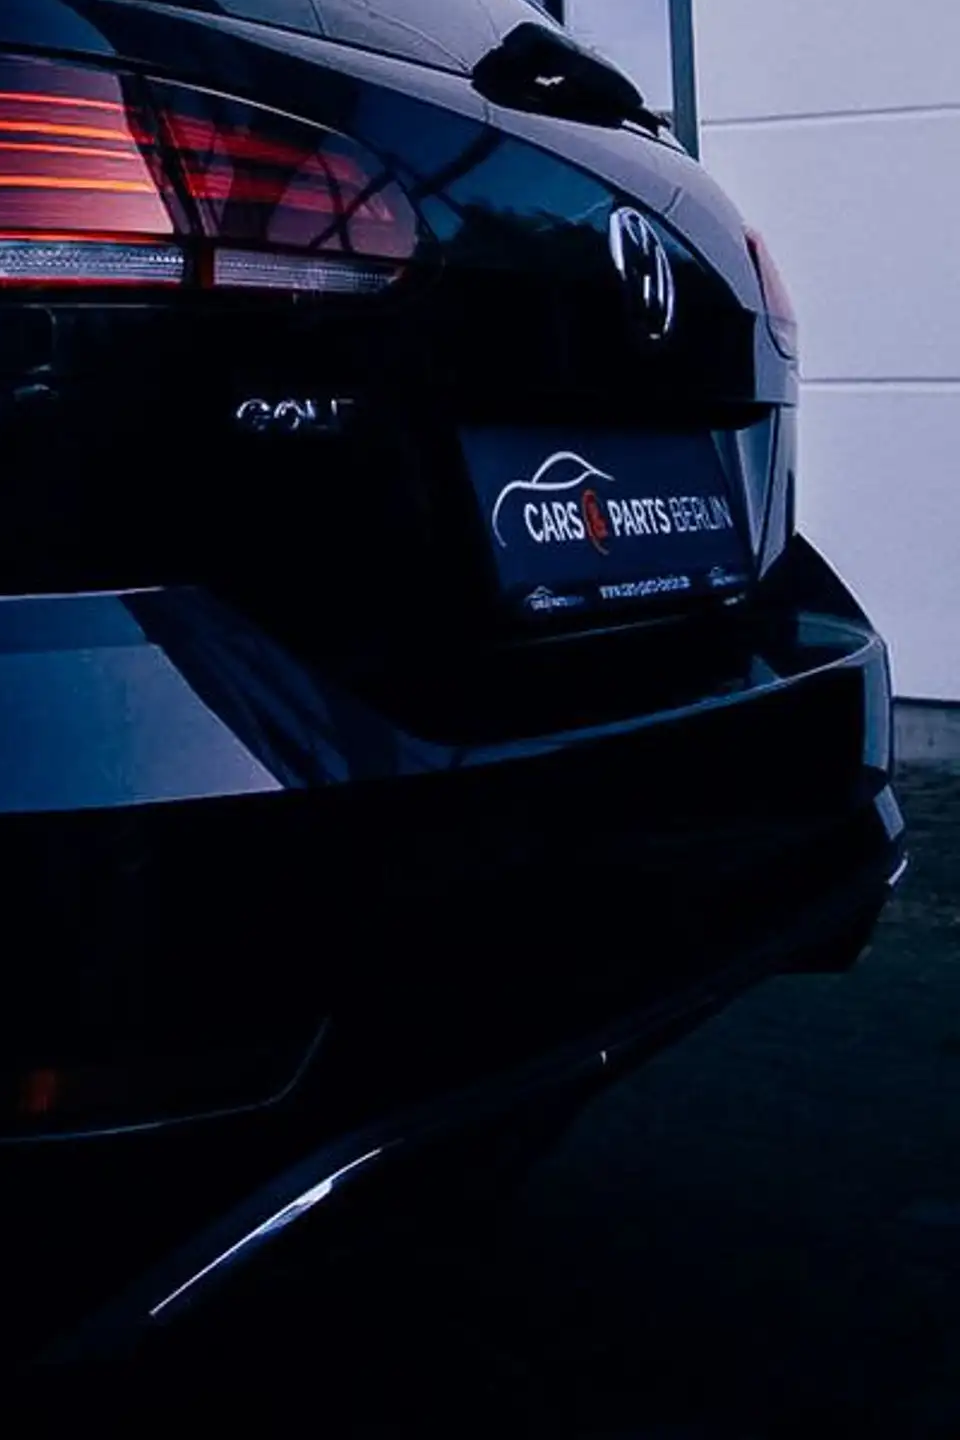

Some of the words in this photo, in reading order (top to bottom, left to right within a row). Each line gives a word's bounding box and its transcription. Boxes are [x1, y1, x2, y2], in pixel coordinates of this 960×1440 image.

[524, 502, 585, 542] CARS
[607, 498, 672, 537] PARTS
[669, 496, 733, 532] BERLIN
